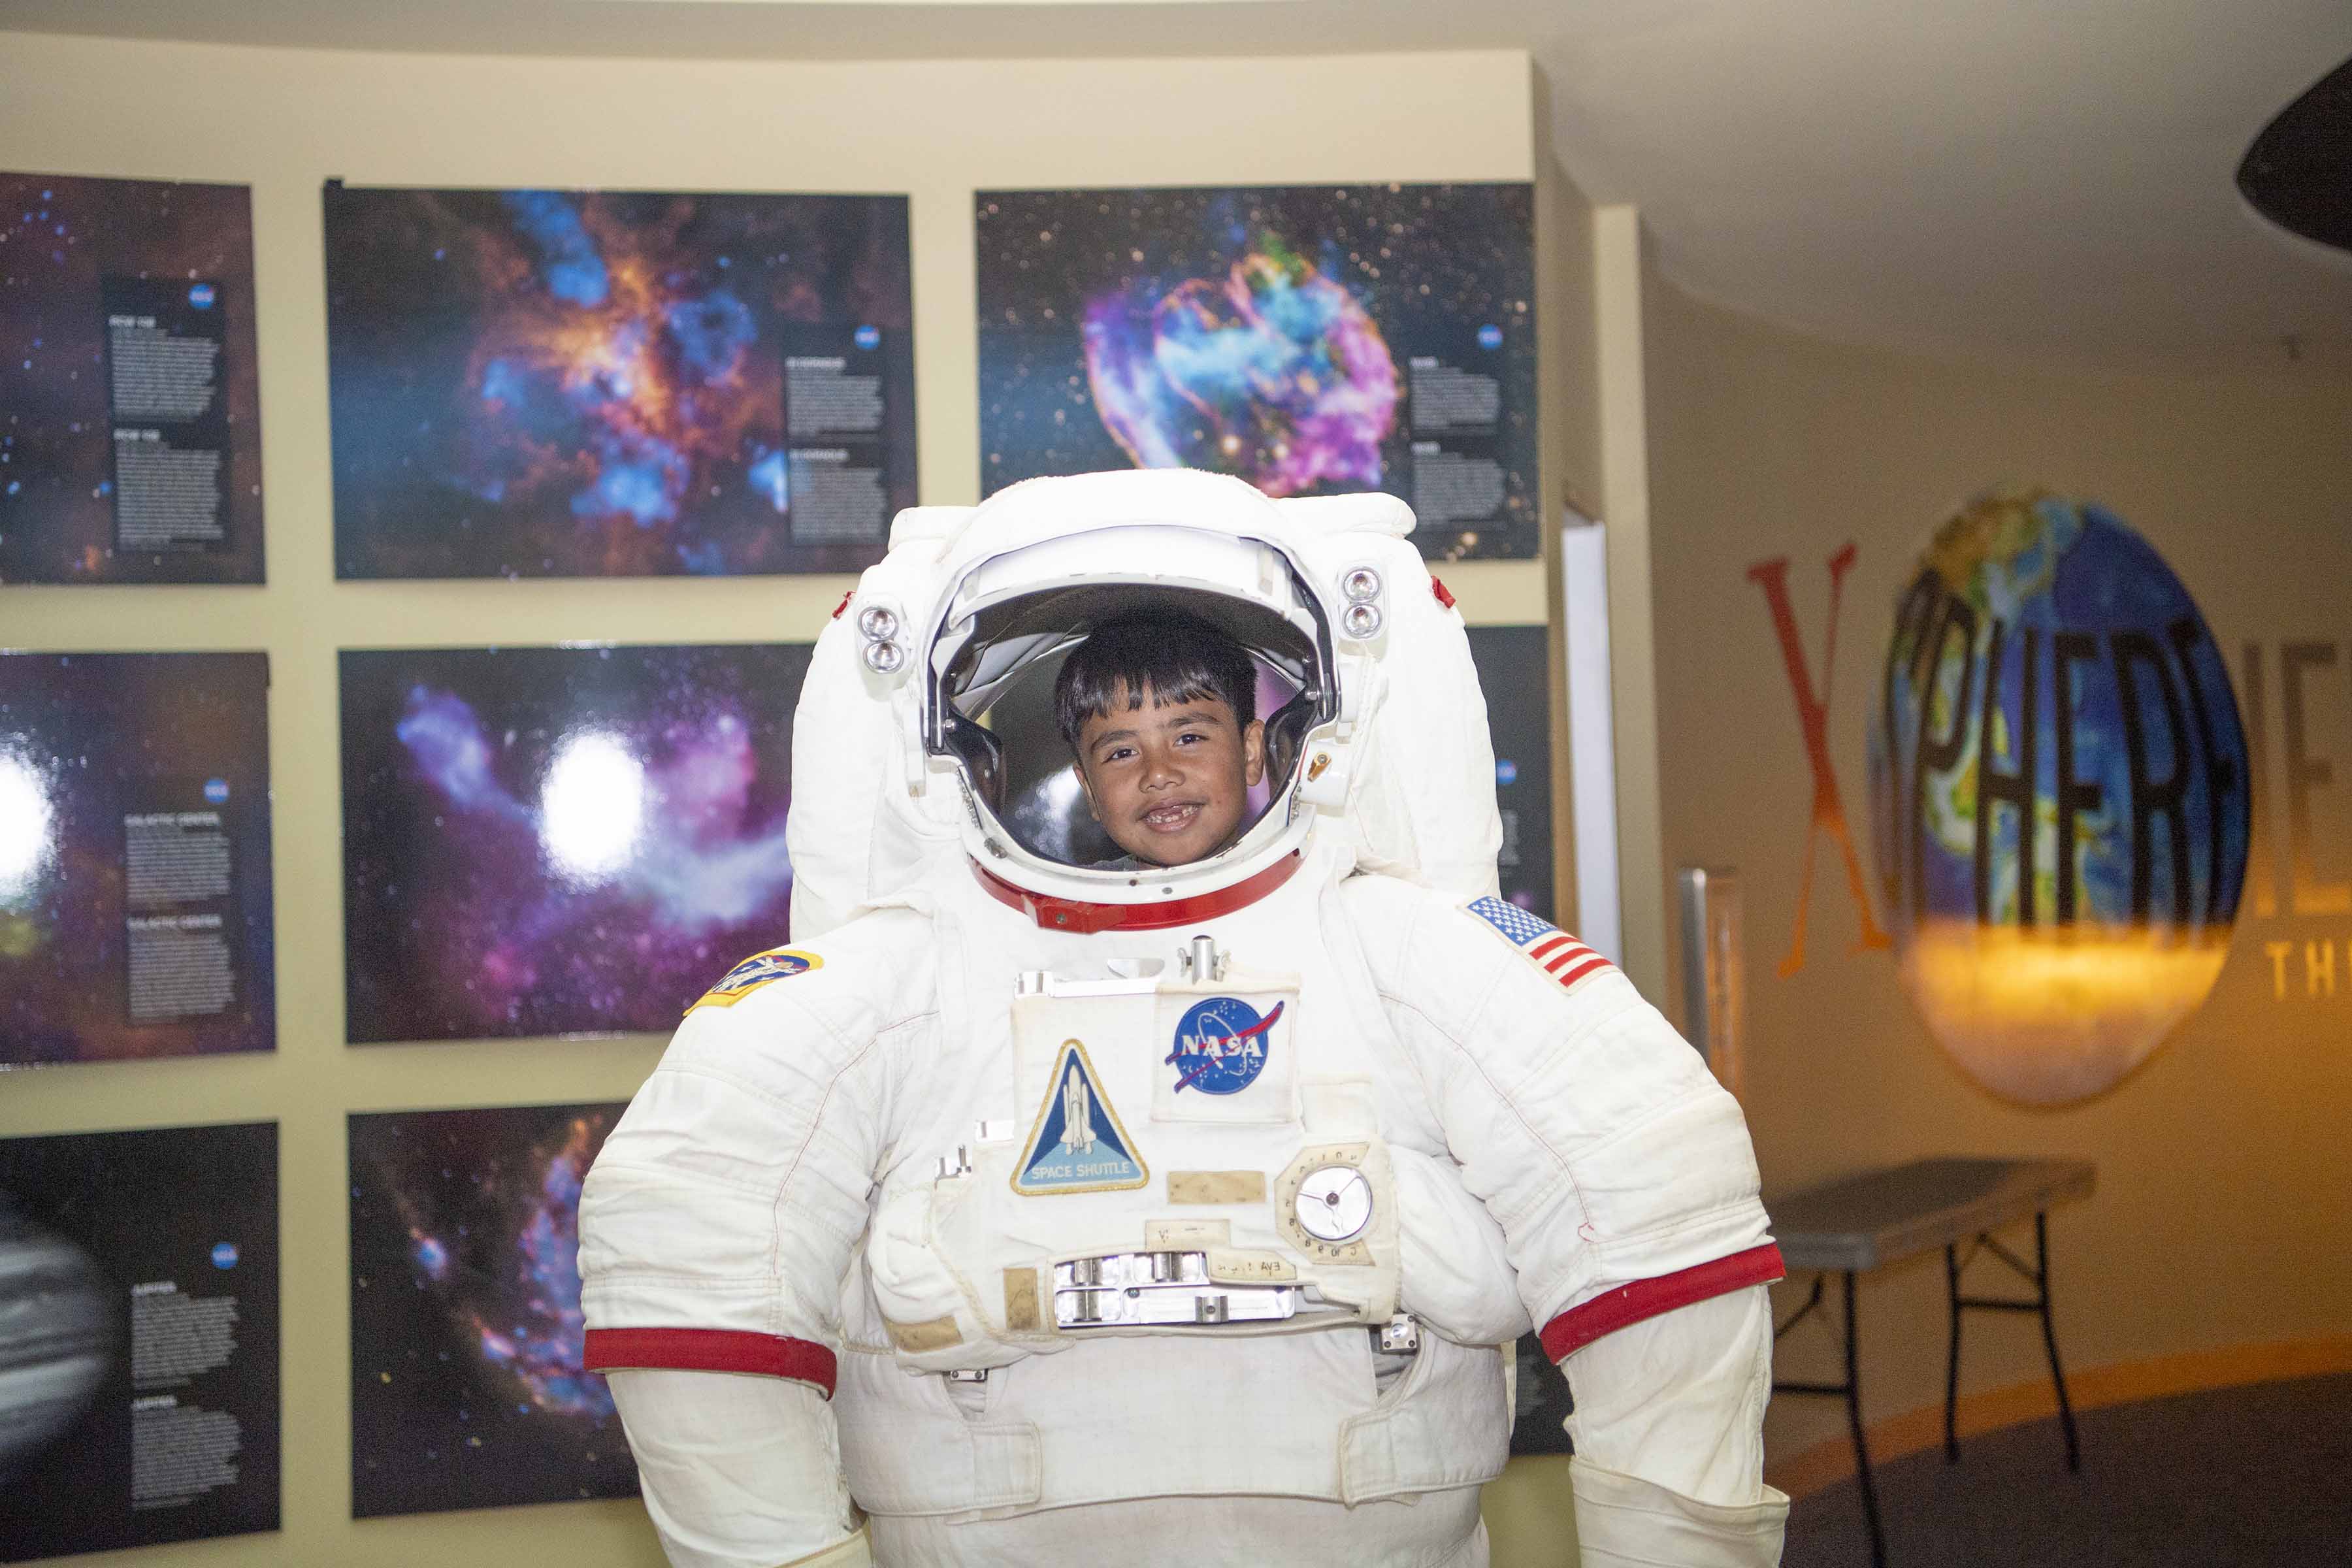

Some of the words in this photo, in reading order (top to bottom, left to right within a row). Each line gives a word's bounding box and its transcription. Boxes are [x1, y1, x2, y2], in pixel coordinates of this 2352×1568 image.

[2264, 938, 2352, 1001] TH
[1181, 1034, 1264, 1057] NASA
[1031, 1165, 1072, 1180] SPACE
[1076, 1160, 1130, 1177] SHUTTLE
